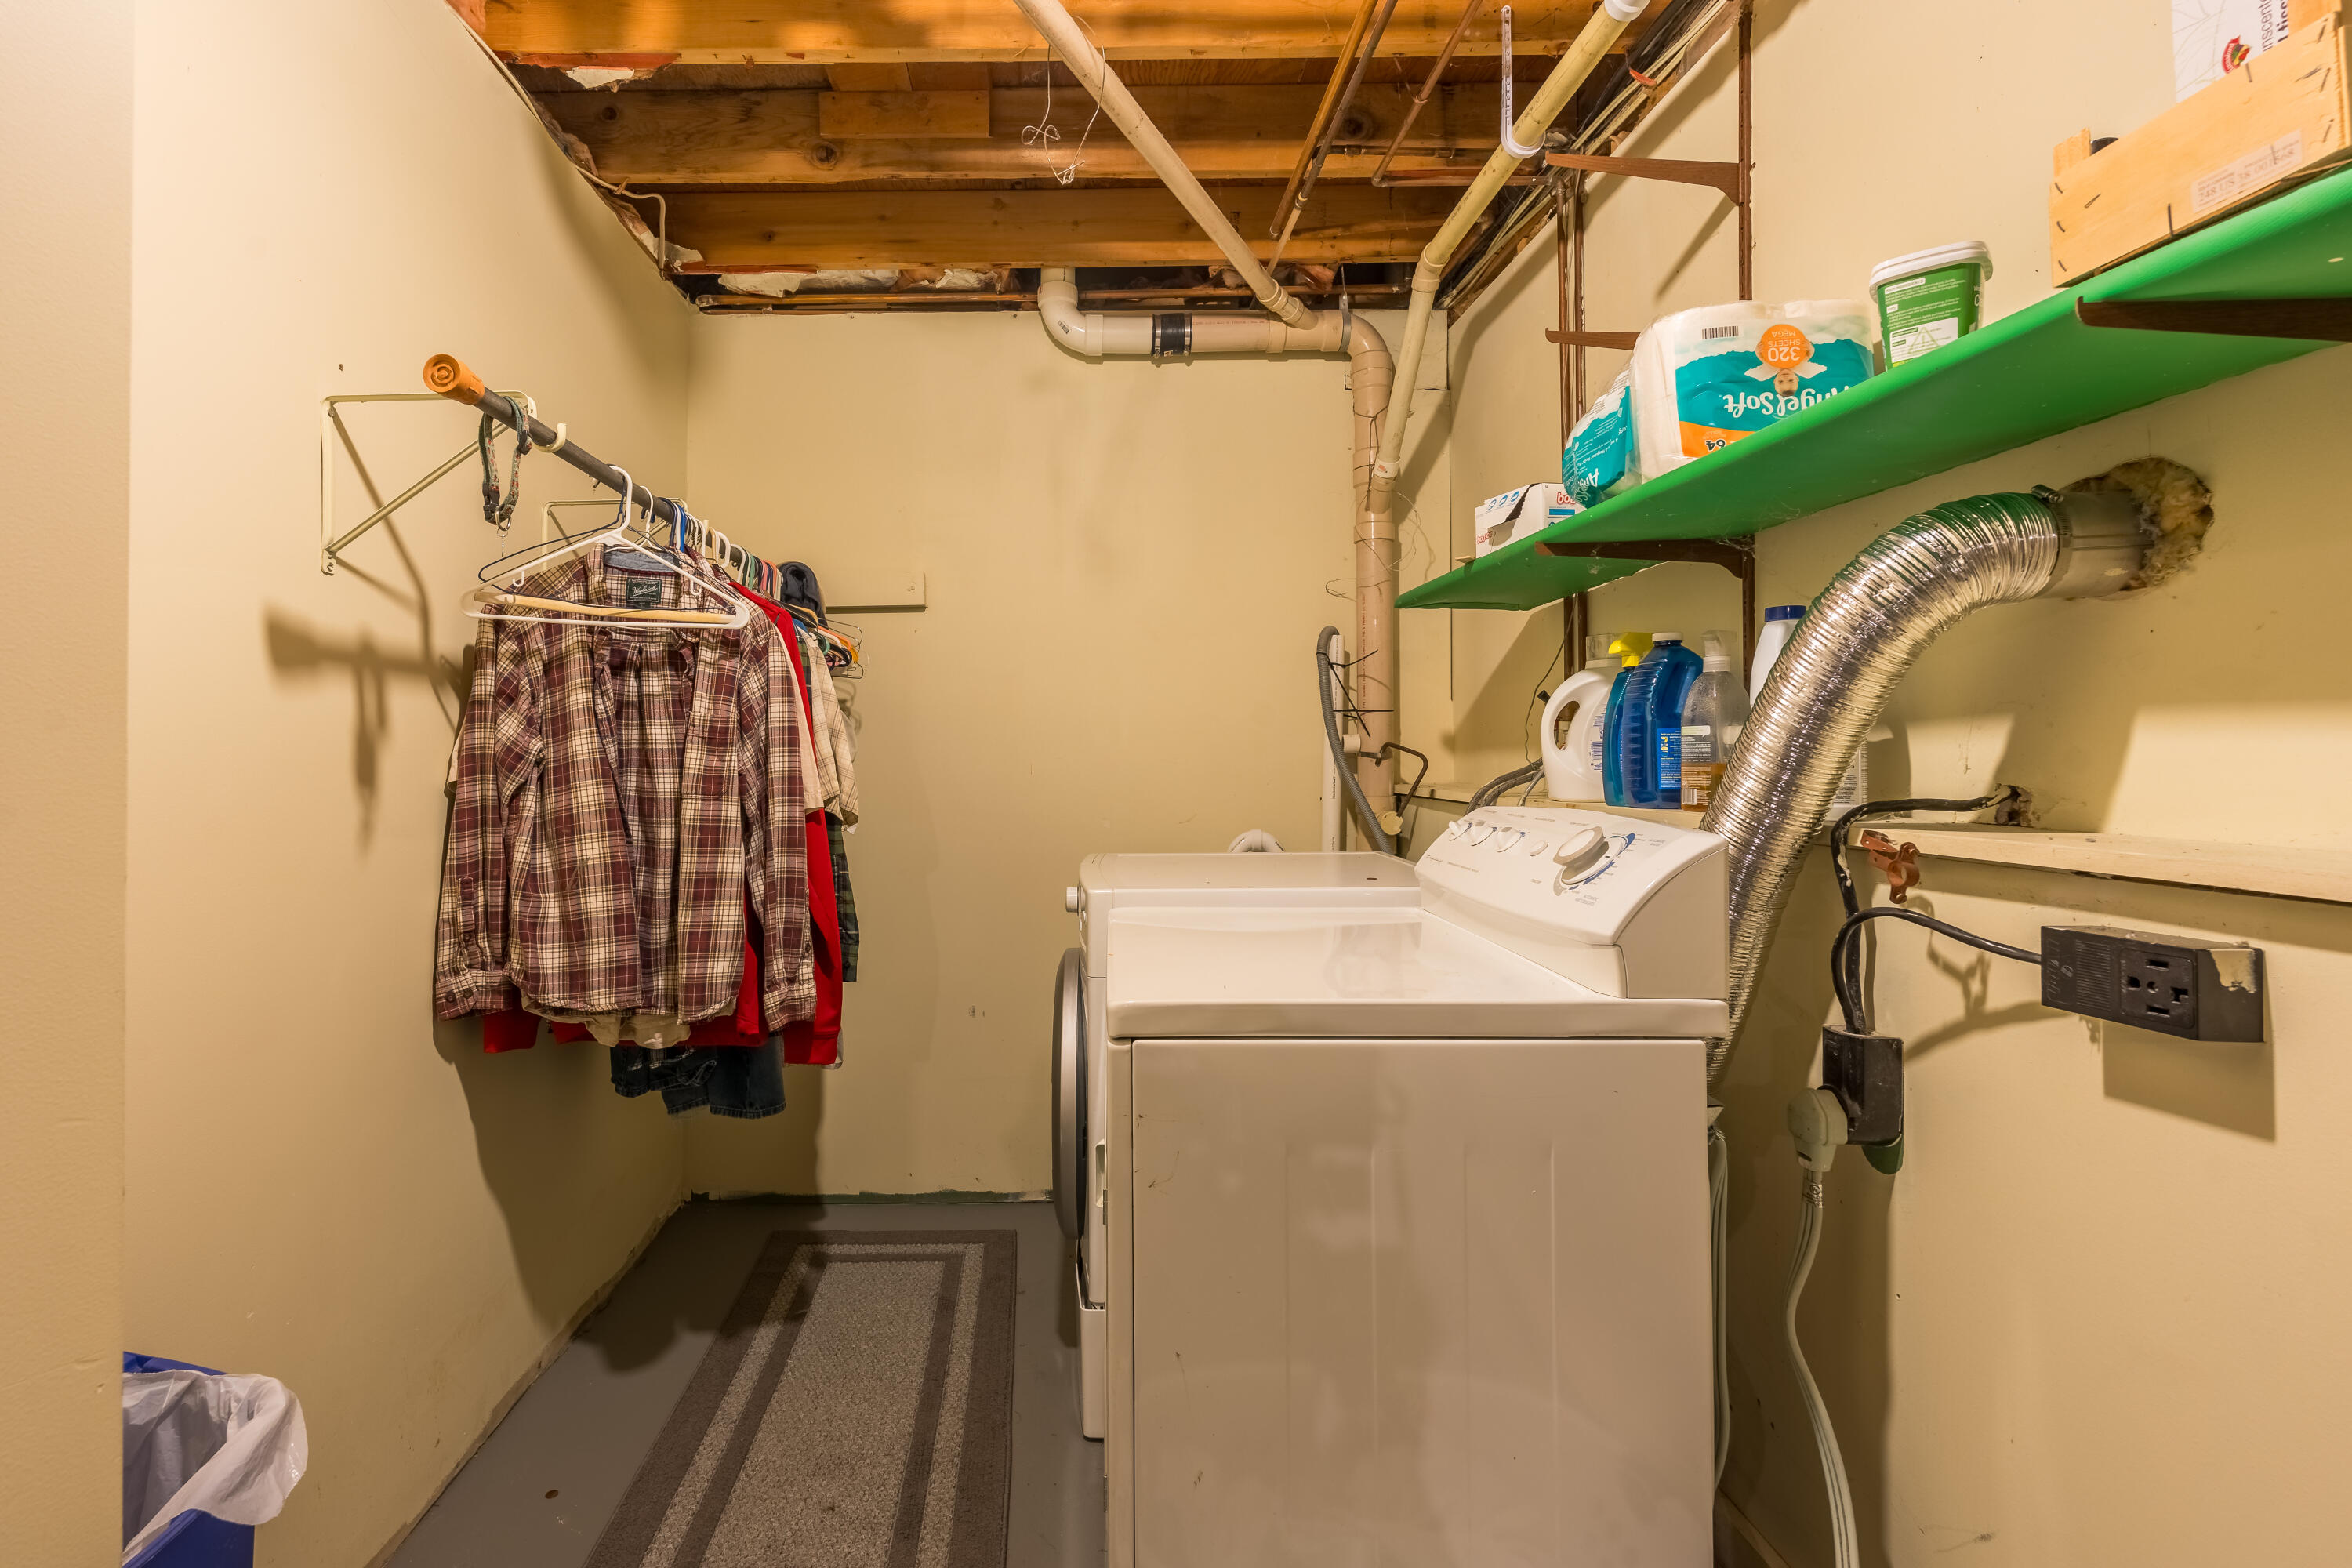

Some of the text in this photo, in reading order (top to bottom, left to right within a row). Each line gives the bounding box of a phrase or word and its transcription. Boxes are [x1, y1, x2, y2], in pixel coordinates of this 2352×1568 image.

[2258, 0, 2273, 51] nscent
[1768, 346, 1801, 362] 320
[1722, 385, 1849, 419] ngel Soft
[1705, 439, 1726, 452] 64
